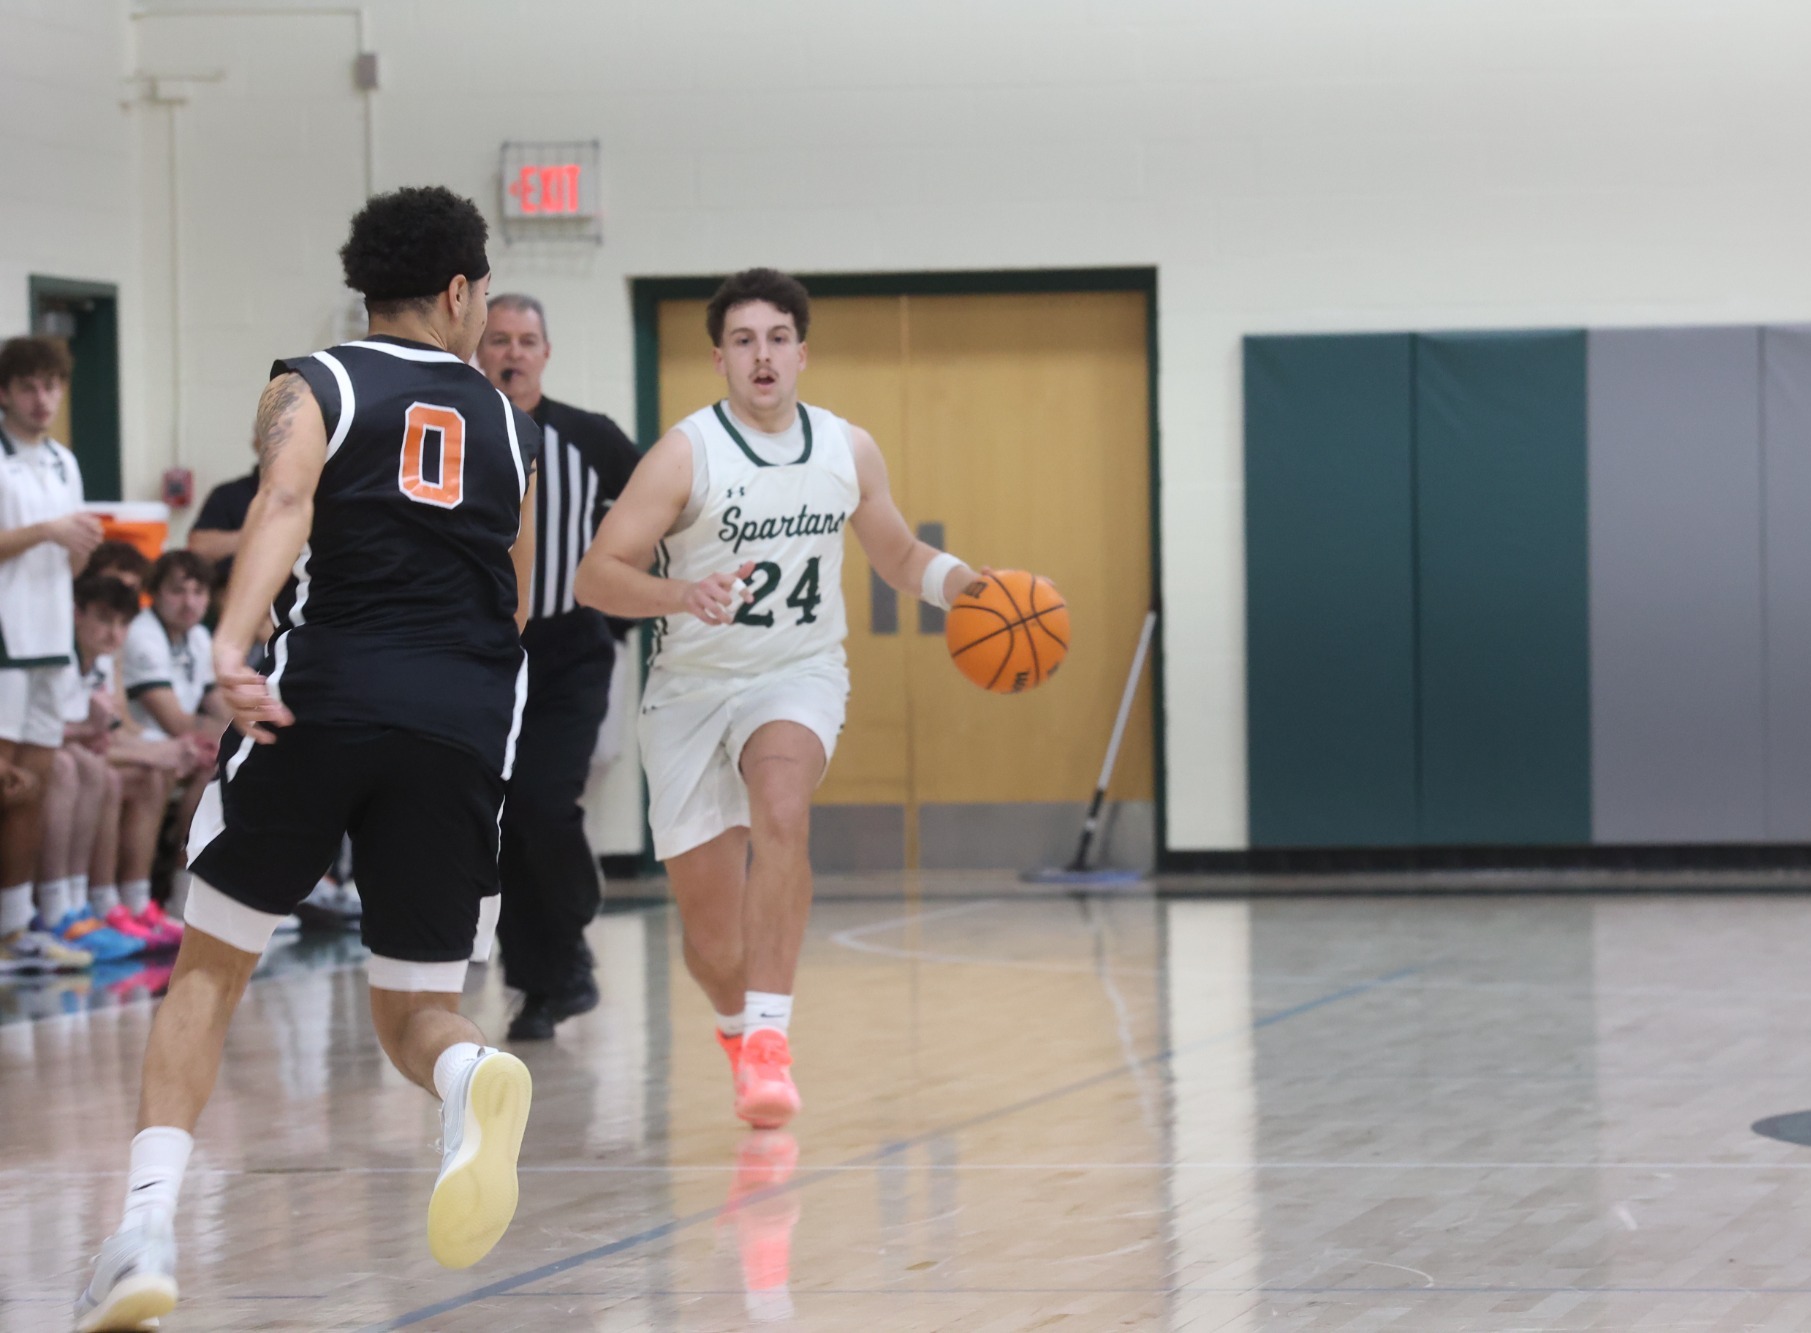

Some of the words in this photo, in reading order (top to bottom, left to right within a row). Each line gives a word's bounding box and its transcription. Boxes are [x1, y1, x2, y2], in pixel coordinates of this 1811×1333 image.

[520, 164, 581, 214] EXIT
[398, 401, 465, 510] 0
[731, 555, 821, 628] 24
